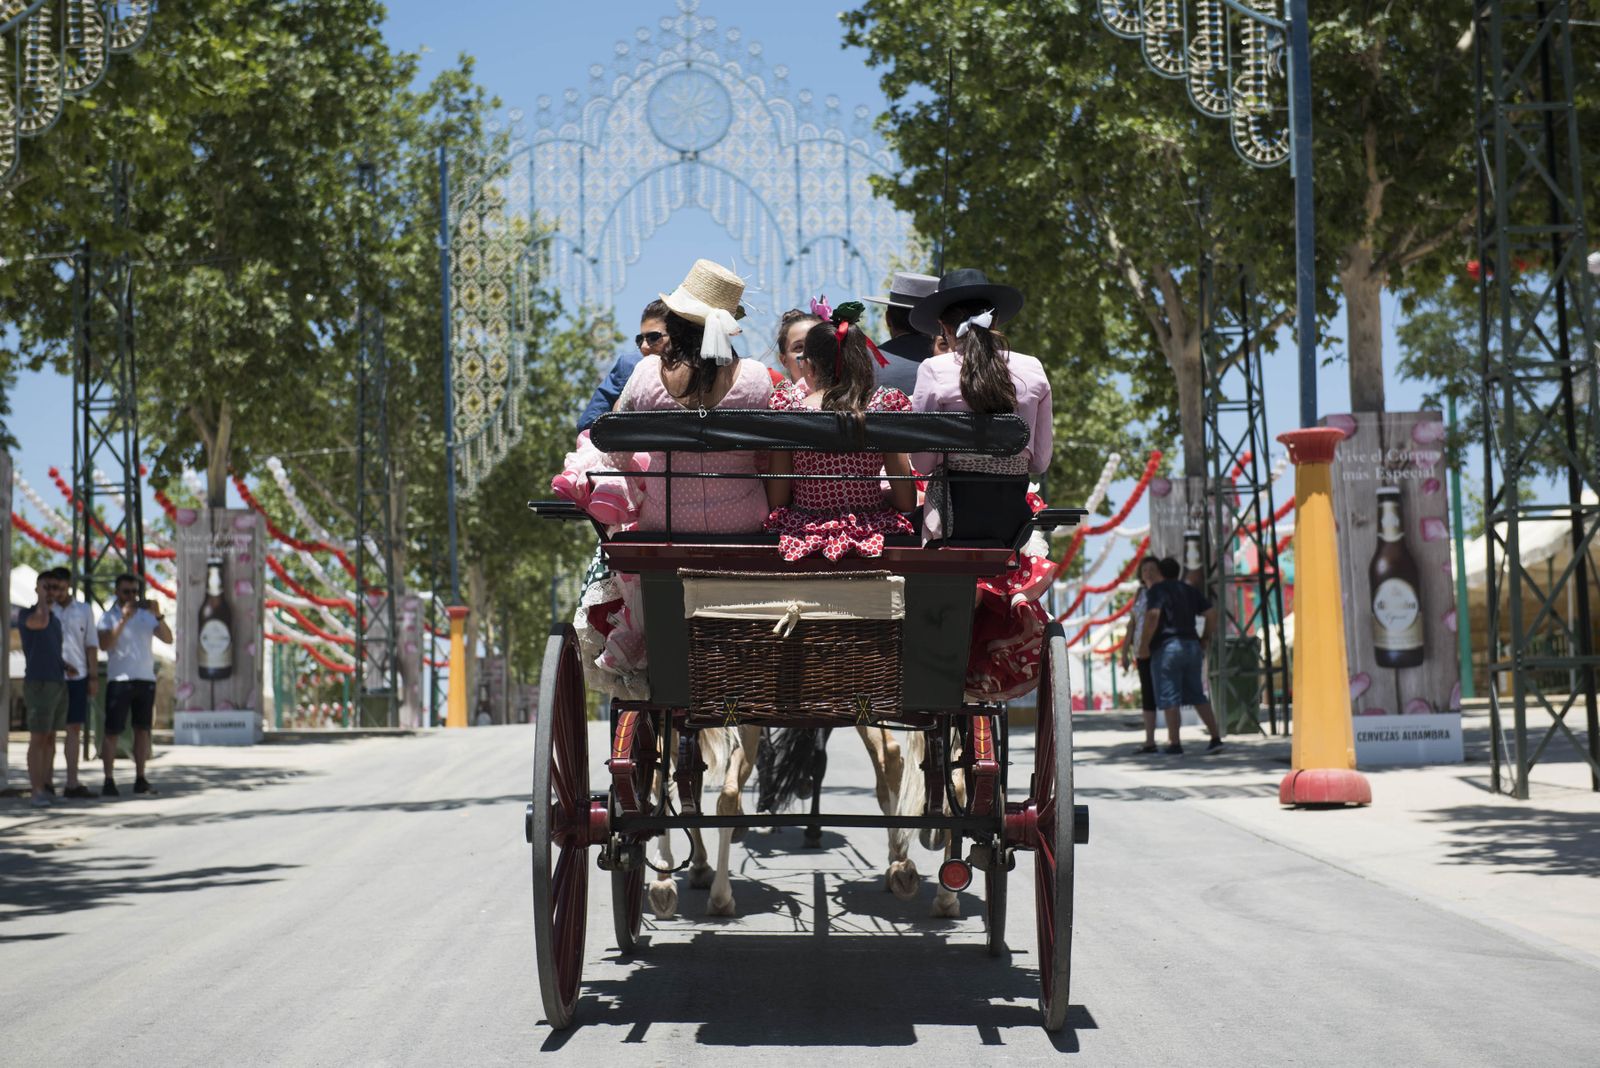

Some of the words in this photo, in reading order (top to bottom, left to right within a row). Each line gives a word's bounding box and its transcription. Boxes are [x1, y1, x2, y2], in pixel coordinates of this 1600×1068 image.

[1335, 448, 1366, 463] Vive
[1370, 448, 1382, 463] el
[1386, 447, 1441, 467] Corpus
[1375, 464, 1435, 483] Especial
[1356, 730, 1400, 742] CERVEZAS
[1401, 728, 1451, 741] ALHAMBRA
